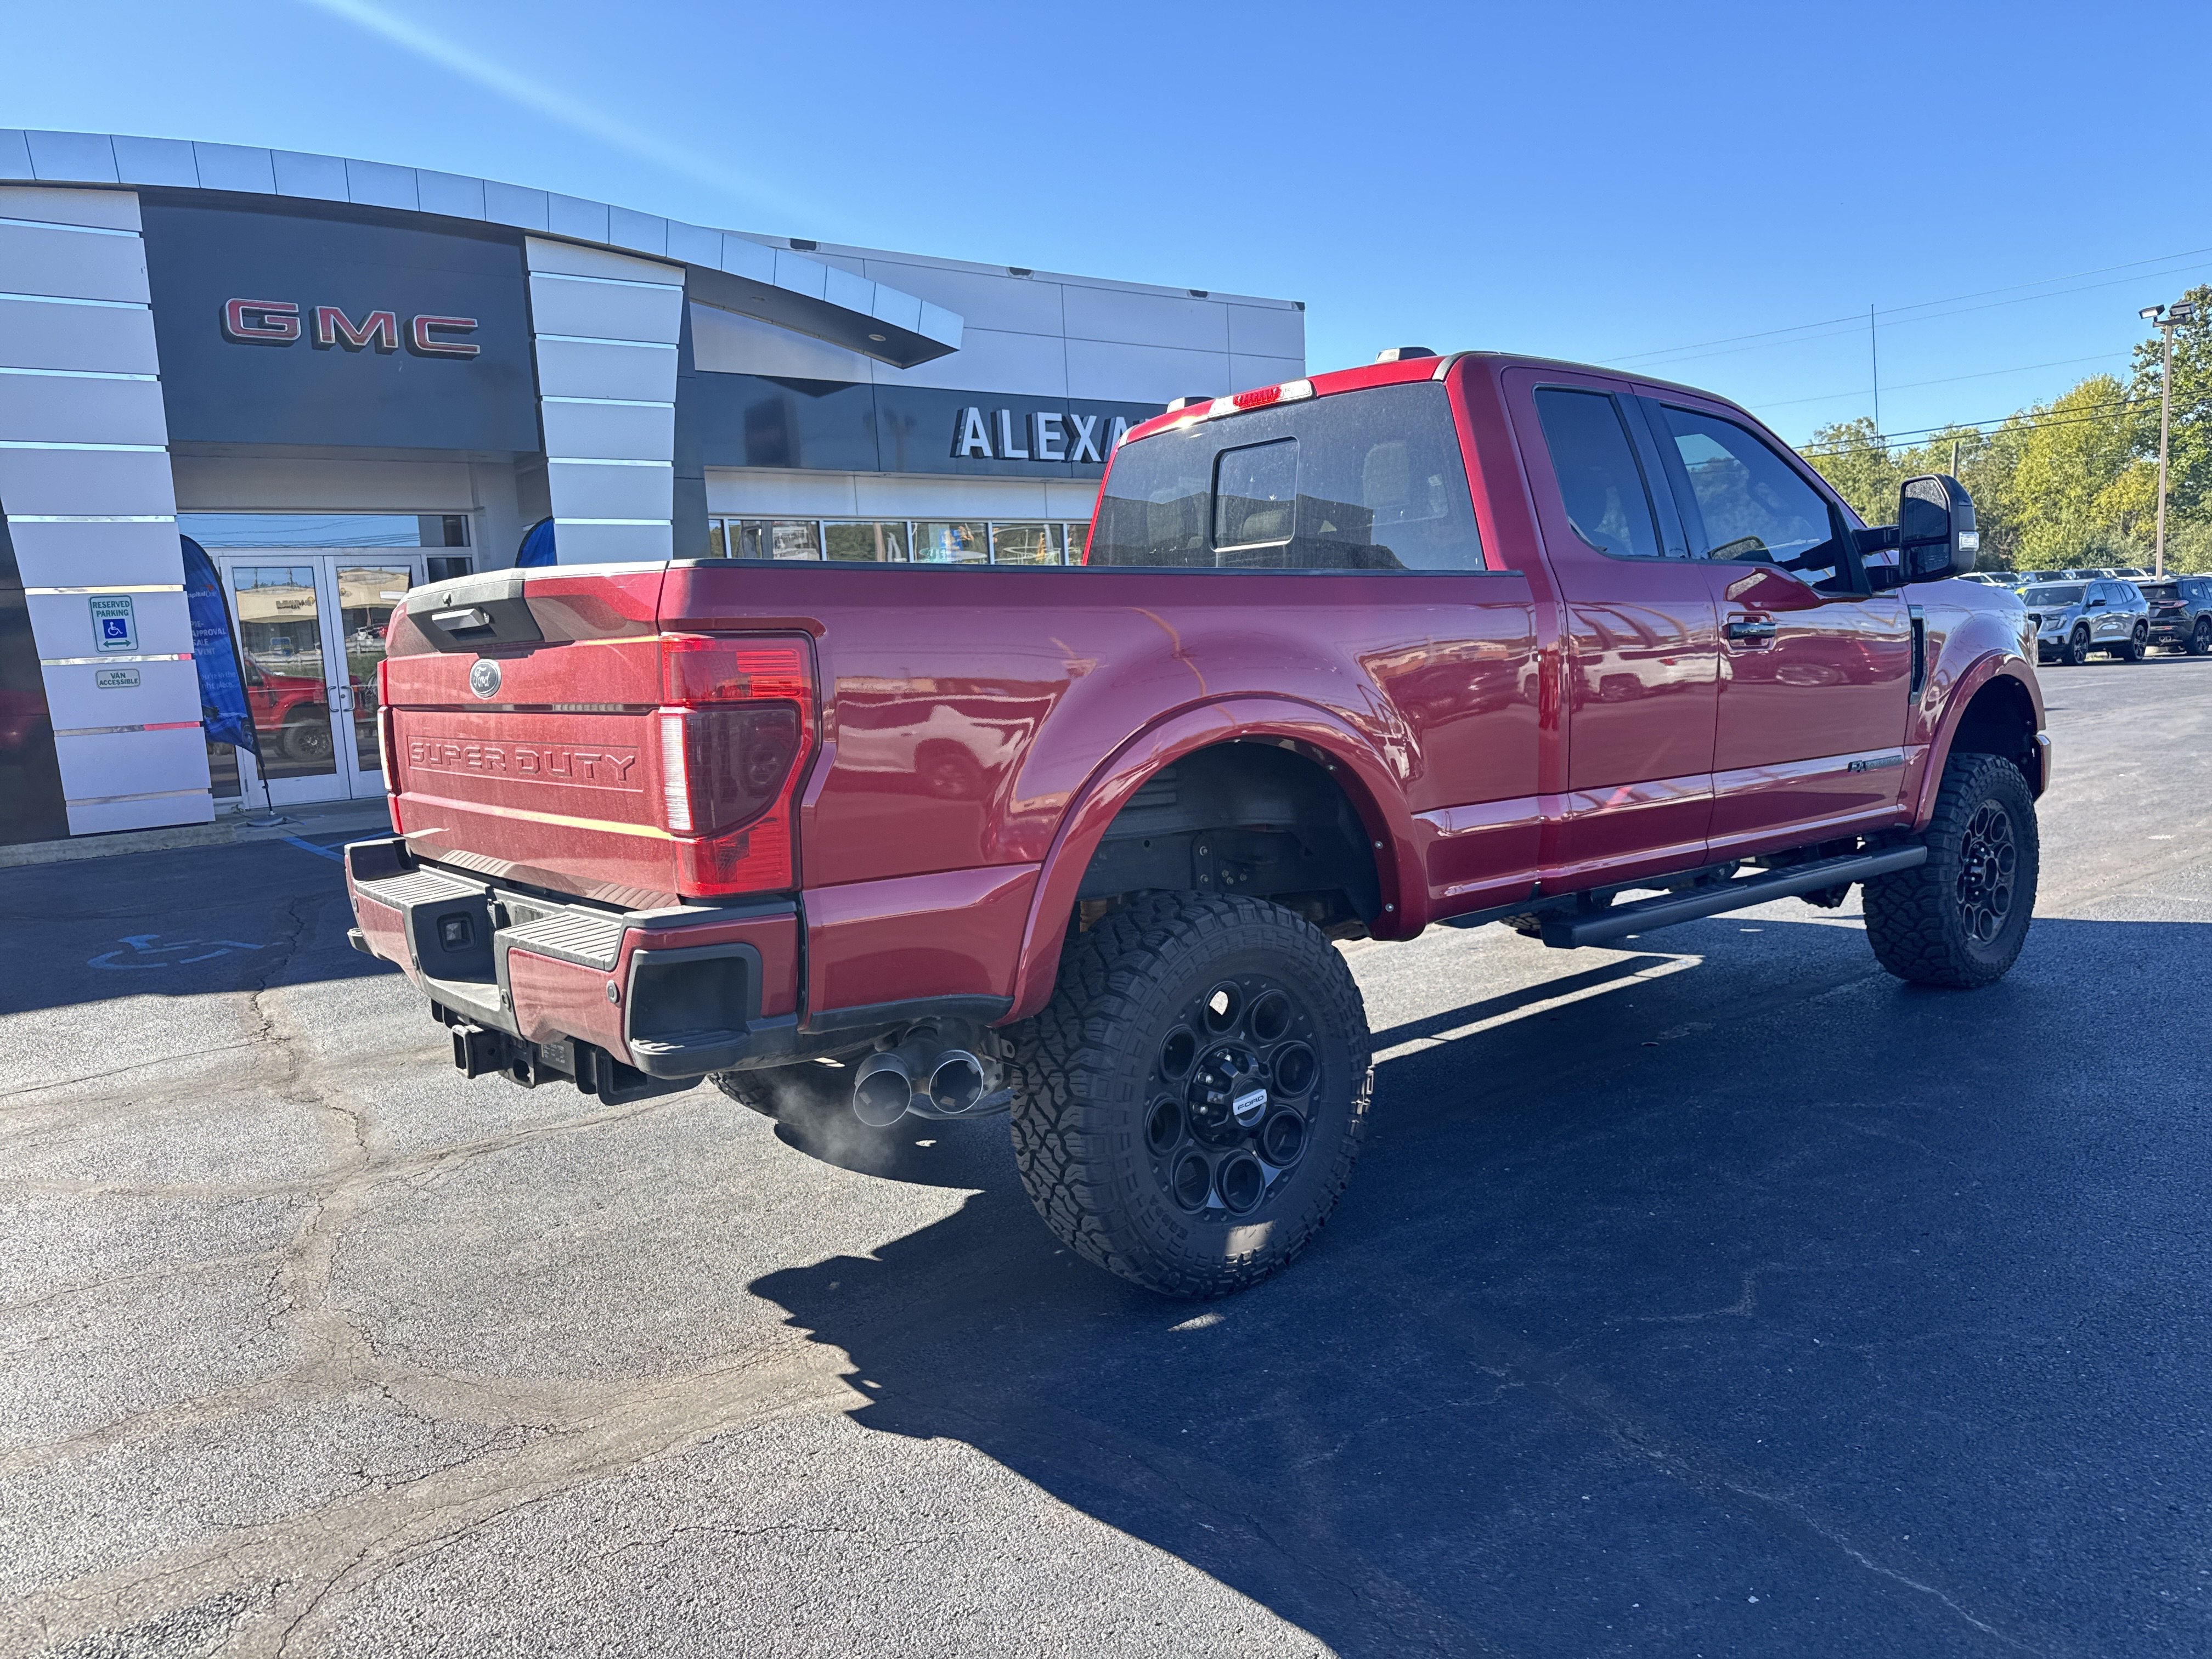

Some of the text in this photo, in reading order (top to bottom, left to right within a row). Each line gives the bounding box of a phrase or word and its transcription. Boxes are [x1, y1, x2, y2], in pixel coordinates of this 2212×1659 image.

[223, 298, 481, 357] GMC
[957, 407, 1148, 462] ALEXA
[92, 600, 130, 609] RESERVED
[96, 609, 129, 617] PARKING
[473, 666, 491, 688] Ford
[410, 742, 636, 782] SUPER DUTY
[1237, 1095, 1264, 1110] FORD
